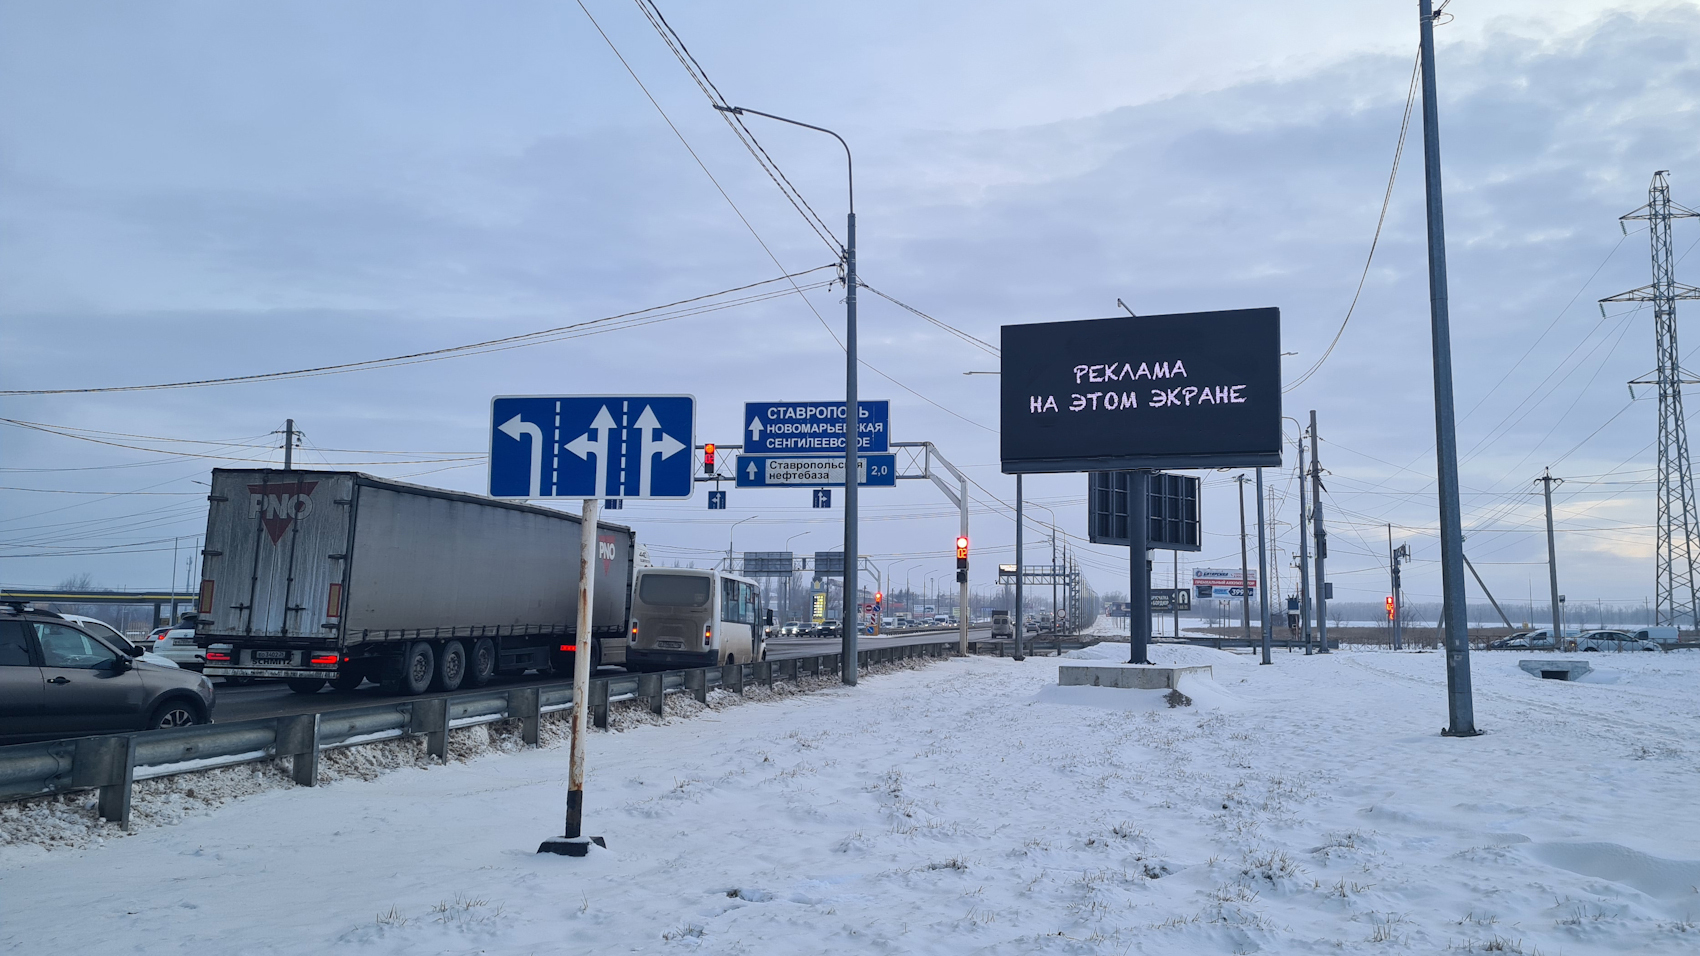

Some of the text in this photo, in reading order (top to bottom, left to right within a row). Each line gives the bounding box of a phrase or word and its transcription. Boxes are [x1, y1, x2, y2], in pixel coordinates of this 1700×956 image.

[1073, 360, 1187, 384] РЕКЛАМА
[1029, 385, 1247, 413] НА ЭТОМ ЭКРАНЕ
[767, 406, 869, 419] СТАВРОПОЬ
[766, 422, 883, 434] НОВОМАРЬЕВКАЯ
[766, 437, 870, 448] СЕНГИЛЕЕВСОЕ
[769, 460, 863, 472] Ставрополься
[871, 466, 888, 477] 2,0
[769, 471, 829, 482] нефтебаза
[248, 493, 314, 520] PNO
[599, 541, 615, 561] PNO
[957, 548, 967, 559] 02
